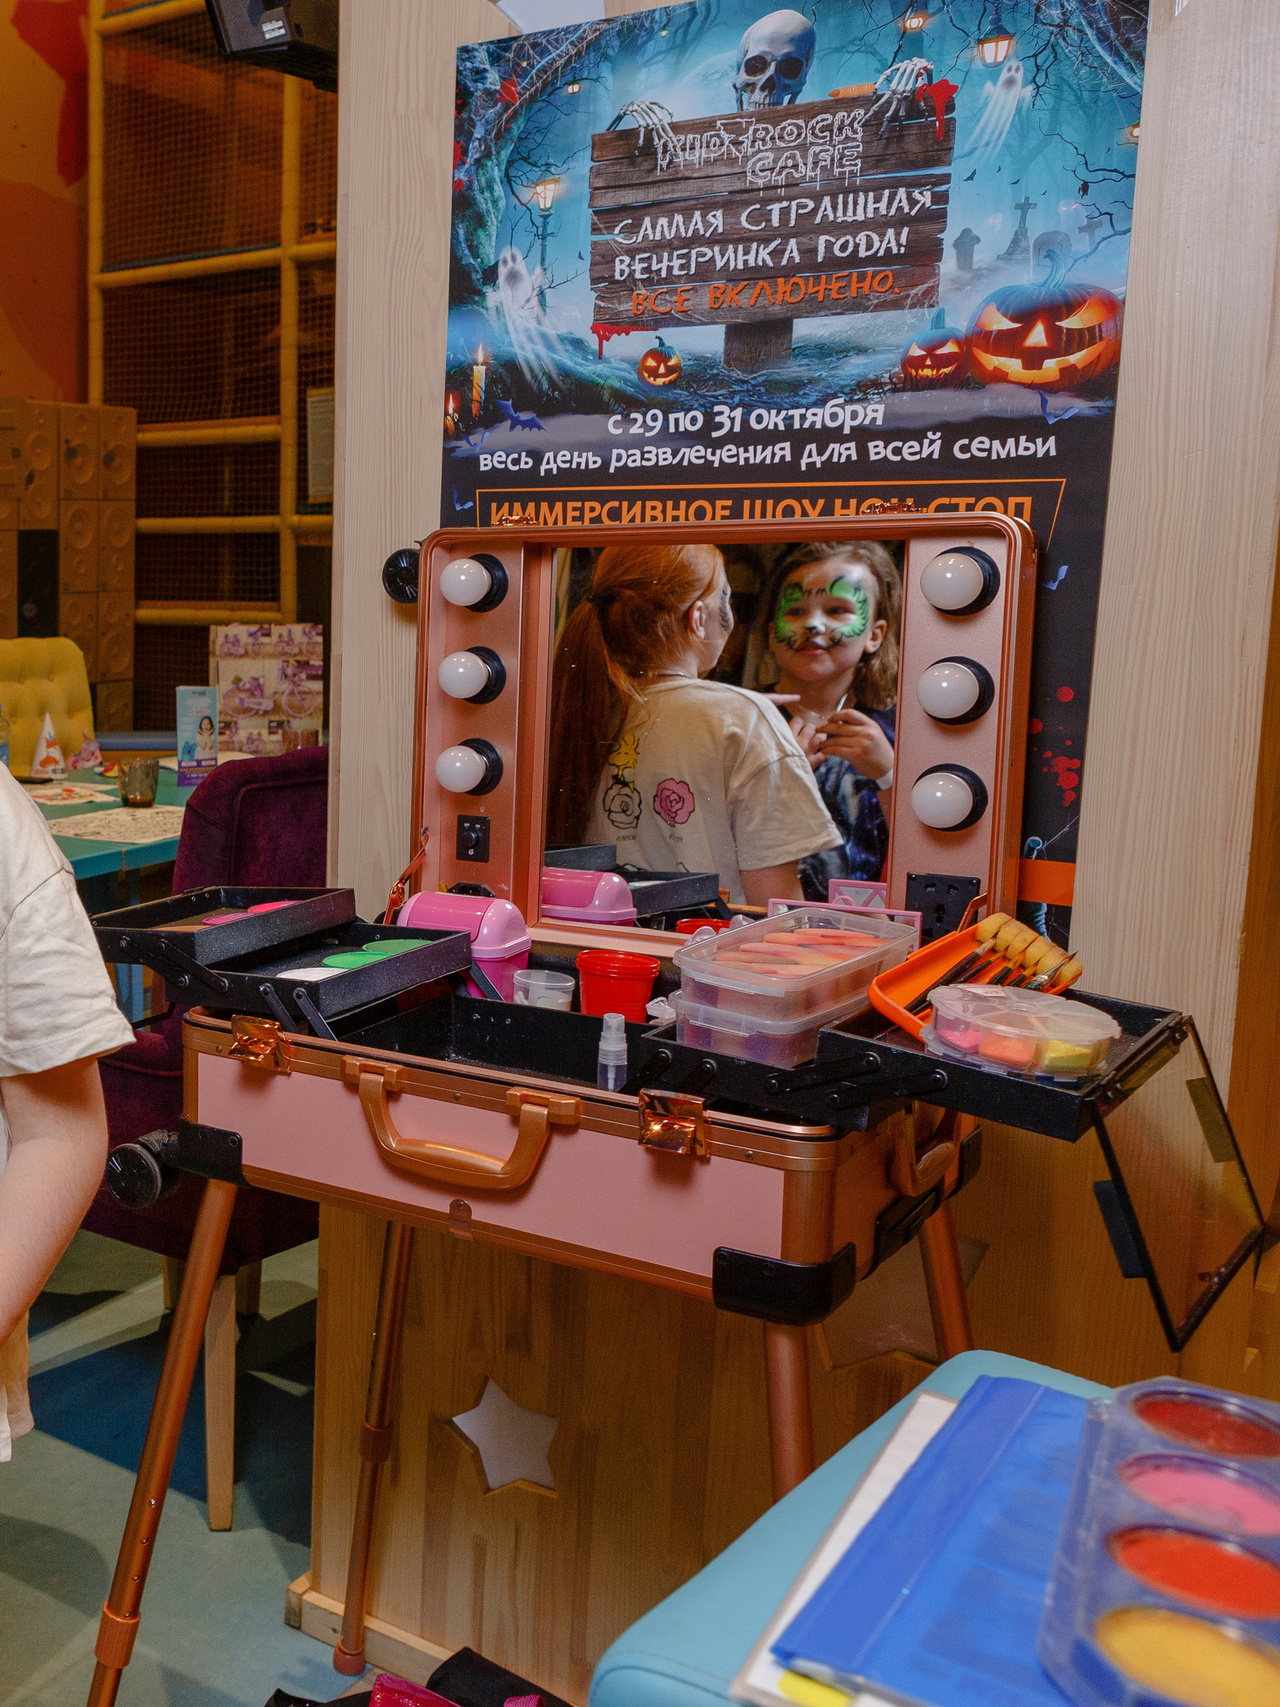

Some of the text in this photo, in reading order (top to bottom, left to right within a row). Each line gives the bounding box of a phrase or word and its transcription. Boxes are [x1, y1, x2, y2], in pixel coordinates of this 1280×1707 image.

[746, 142, 863, 197] CAFE
[614, 187, 932, 245] САМАЯ СТРАШНАЯ
[614, 226, 910, 281] ВЕЧЕРИНКА ГОДА!
[631, 269, 901, 316] ВСЕ ВКЛЮЧЕНО.
[607, 397, 886, 438] с 29 по 31 октября
[479, 431, 1058, 476] весь день развлечения для всей семьи
[490, 499, 733, 526] ИММЕРСИВНОЕ
[742, 498, 825, 519] ШОУ
